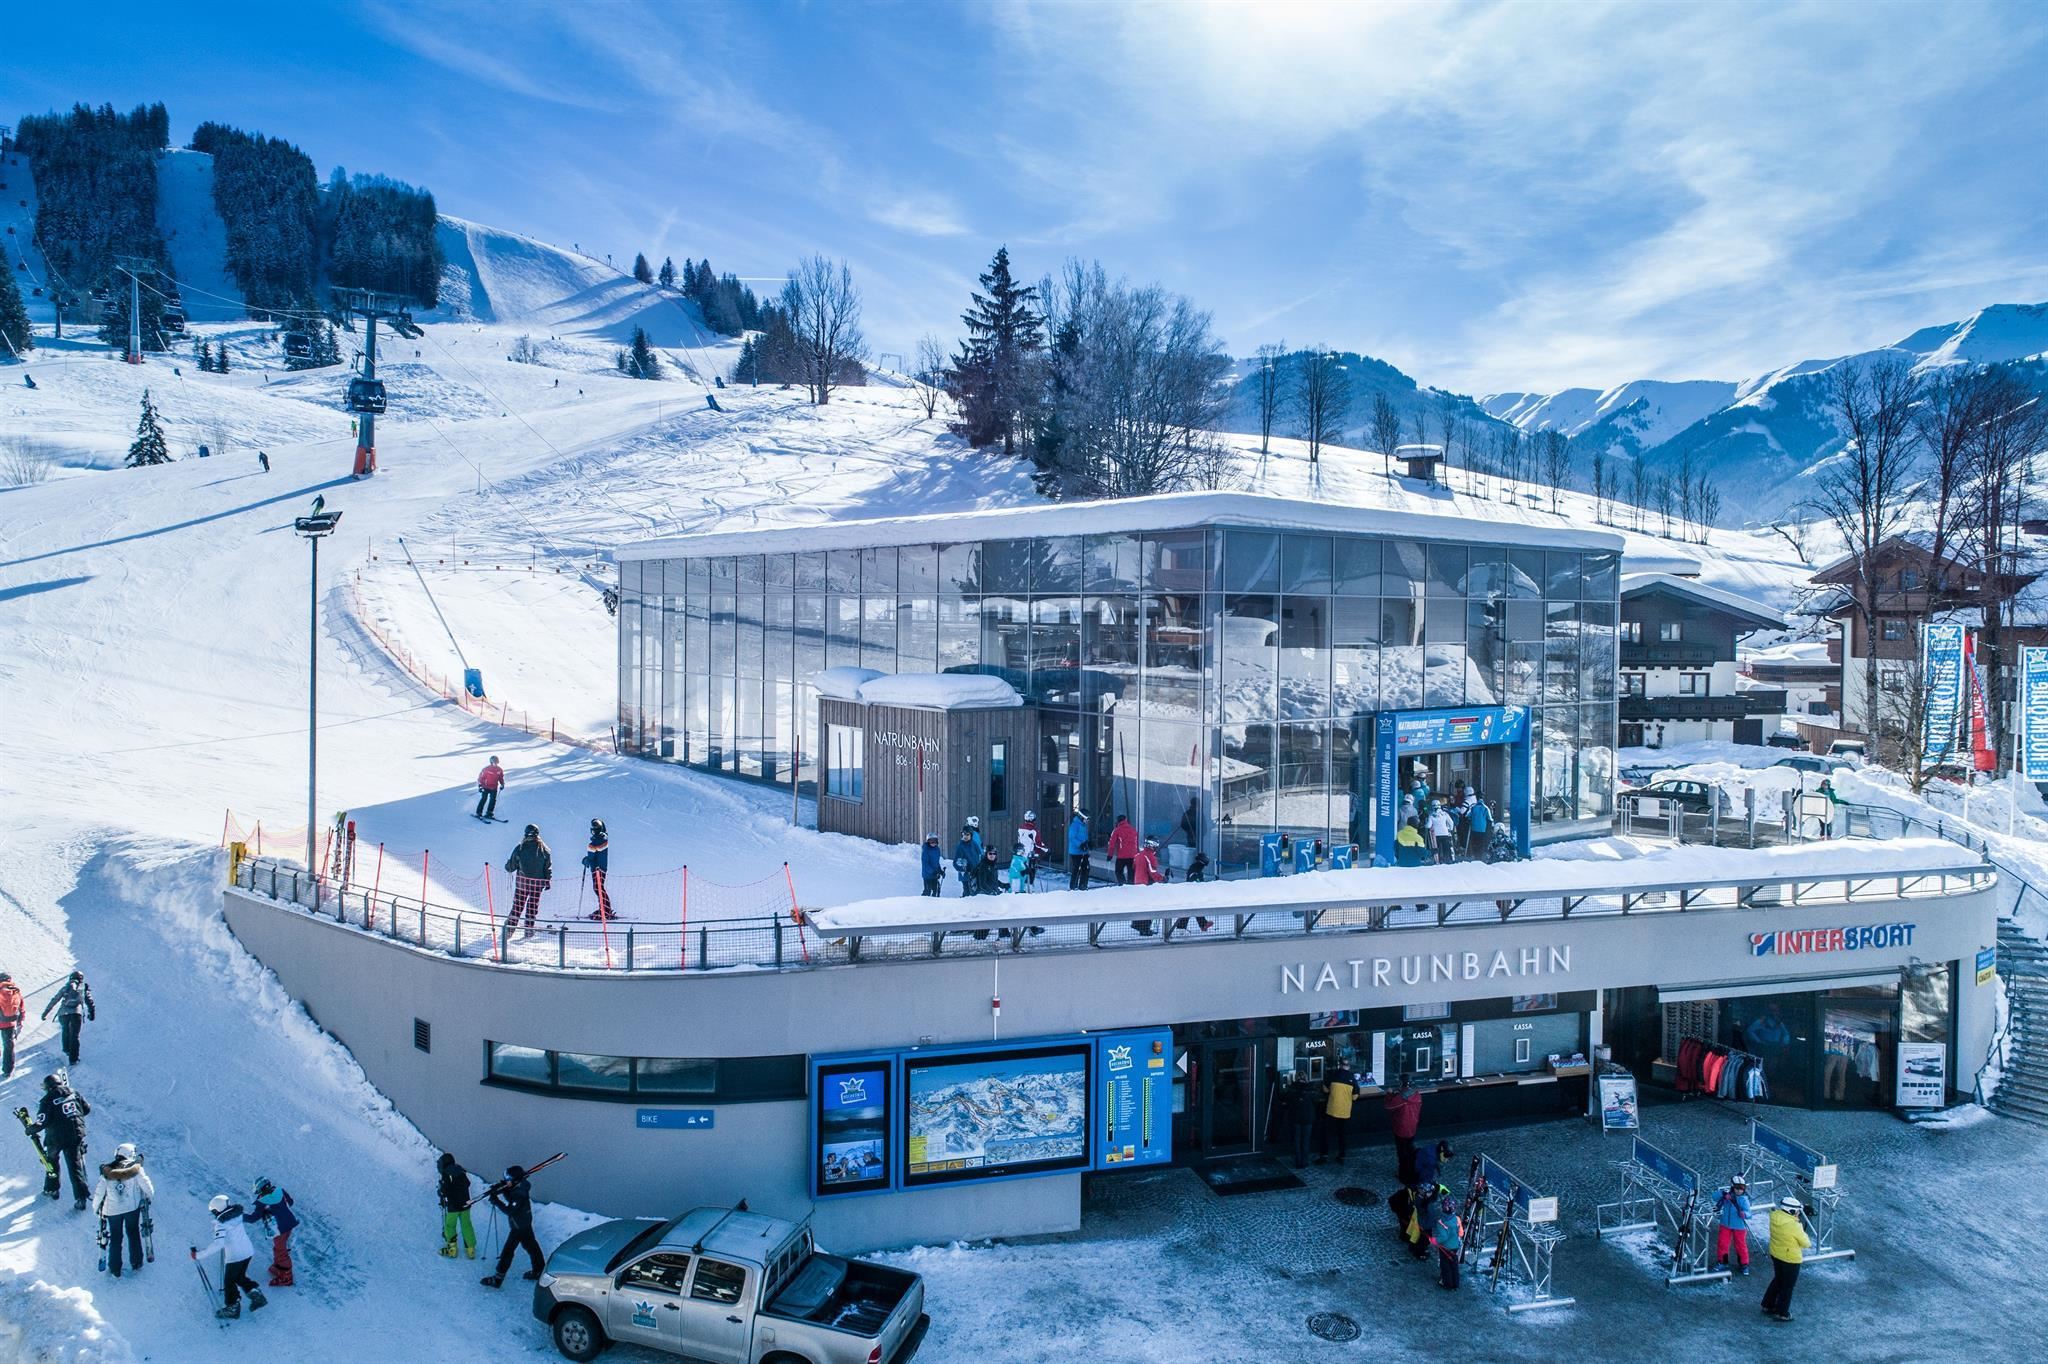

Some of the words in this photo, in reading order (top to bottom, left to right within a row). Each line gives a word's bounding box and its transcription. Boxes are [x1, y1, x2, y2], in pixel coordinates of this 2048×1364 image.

[2028, 681, 2048, 761] HOCHKÖNIG
[874, 731, 940, 752] NATRUNBAHN
[895, 754, 908, 767] 806
[914, 757, 931, 770] 163
[1380, 762, 1391, 817] NATRUNBAHN
[1774, 923, 1917, 956] INTERSPORT
[1280, 945, 1571, 995] NATRUNBAHN
[1412, 1031, 1433, 1040] KASSA
[1513, 1023, 1533, 1031] KASSA
[1305, 1040, 1327, 1049] KASSA
[641, 1115, 658, 1123] BIKE
